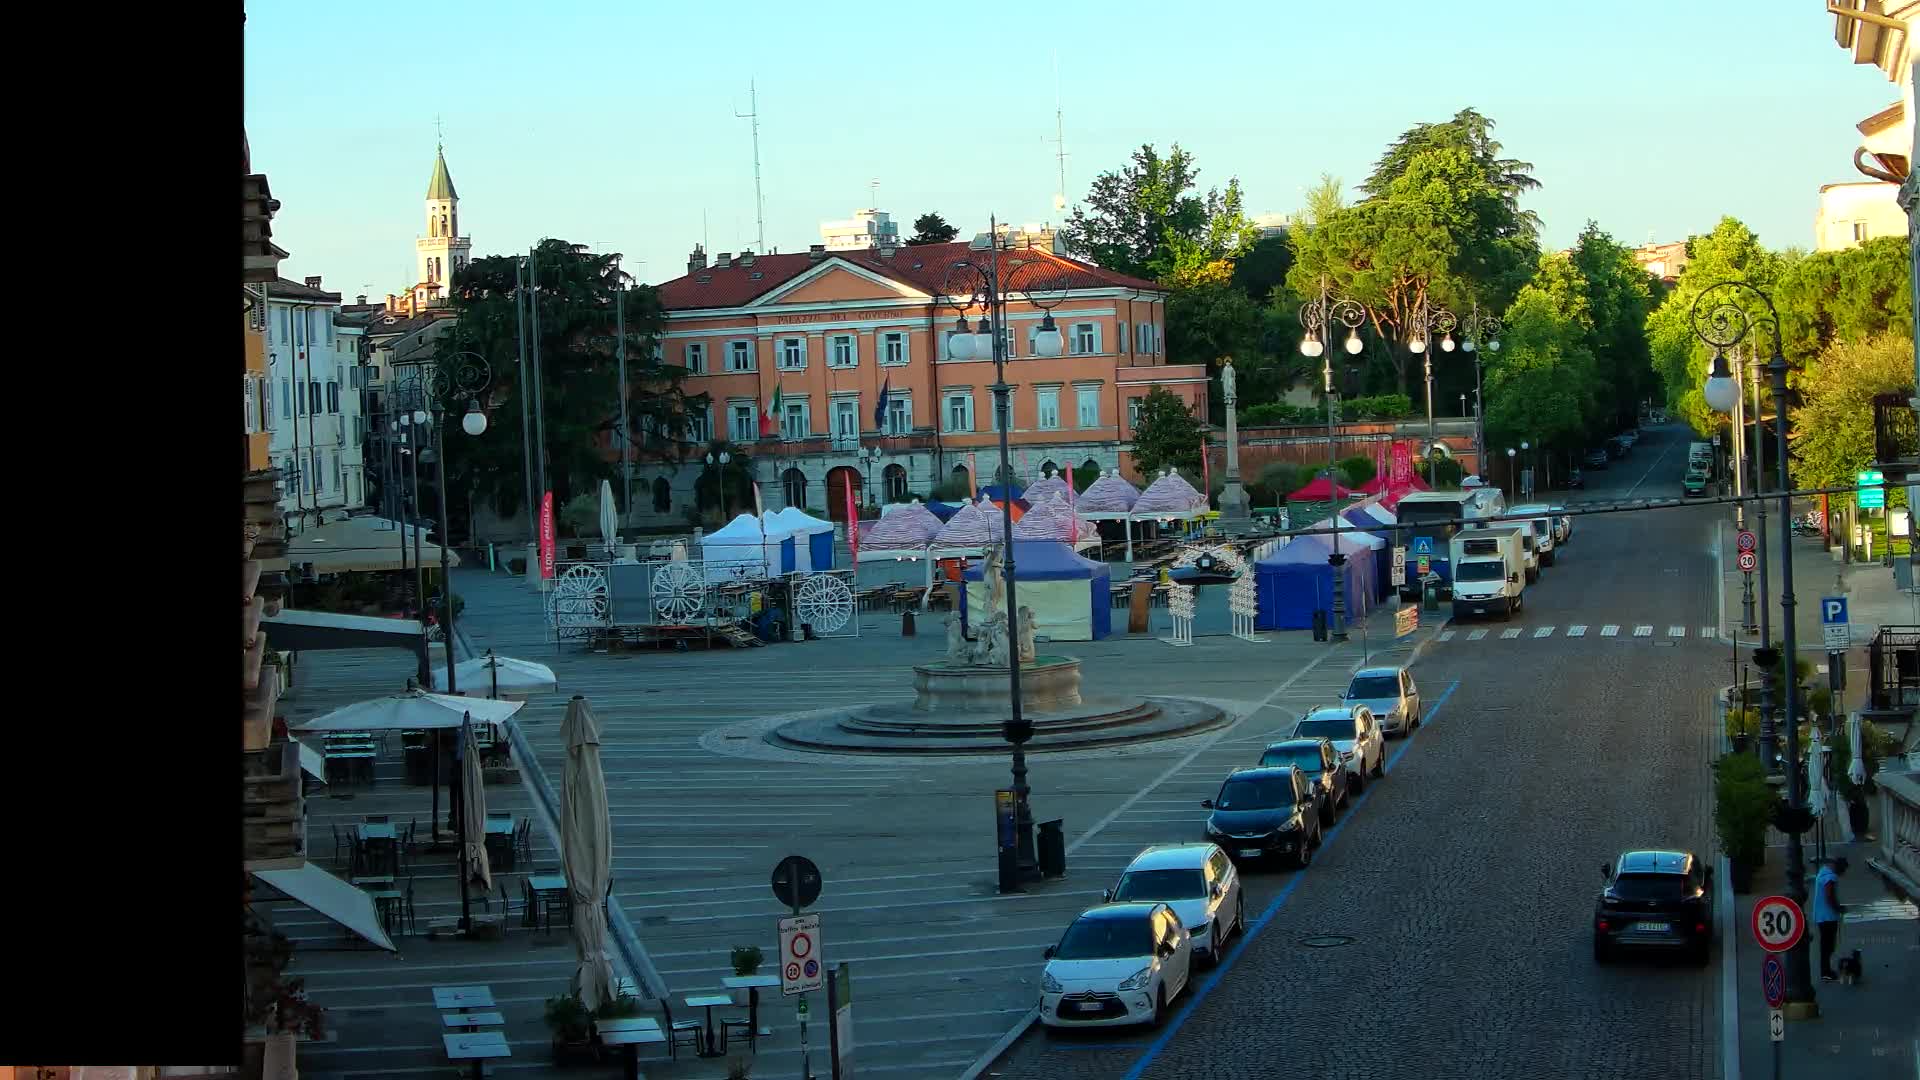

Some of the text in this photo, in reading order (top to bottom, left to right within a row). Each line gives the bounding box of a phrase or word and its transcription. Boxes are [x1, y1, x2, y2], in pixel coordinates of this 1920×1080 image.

[1742, 557, 1752, 566] 20
[1827, 601, 1842, 621] P
[1762, 911, 1791, 936] 30
